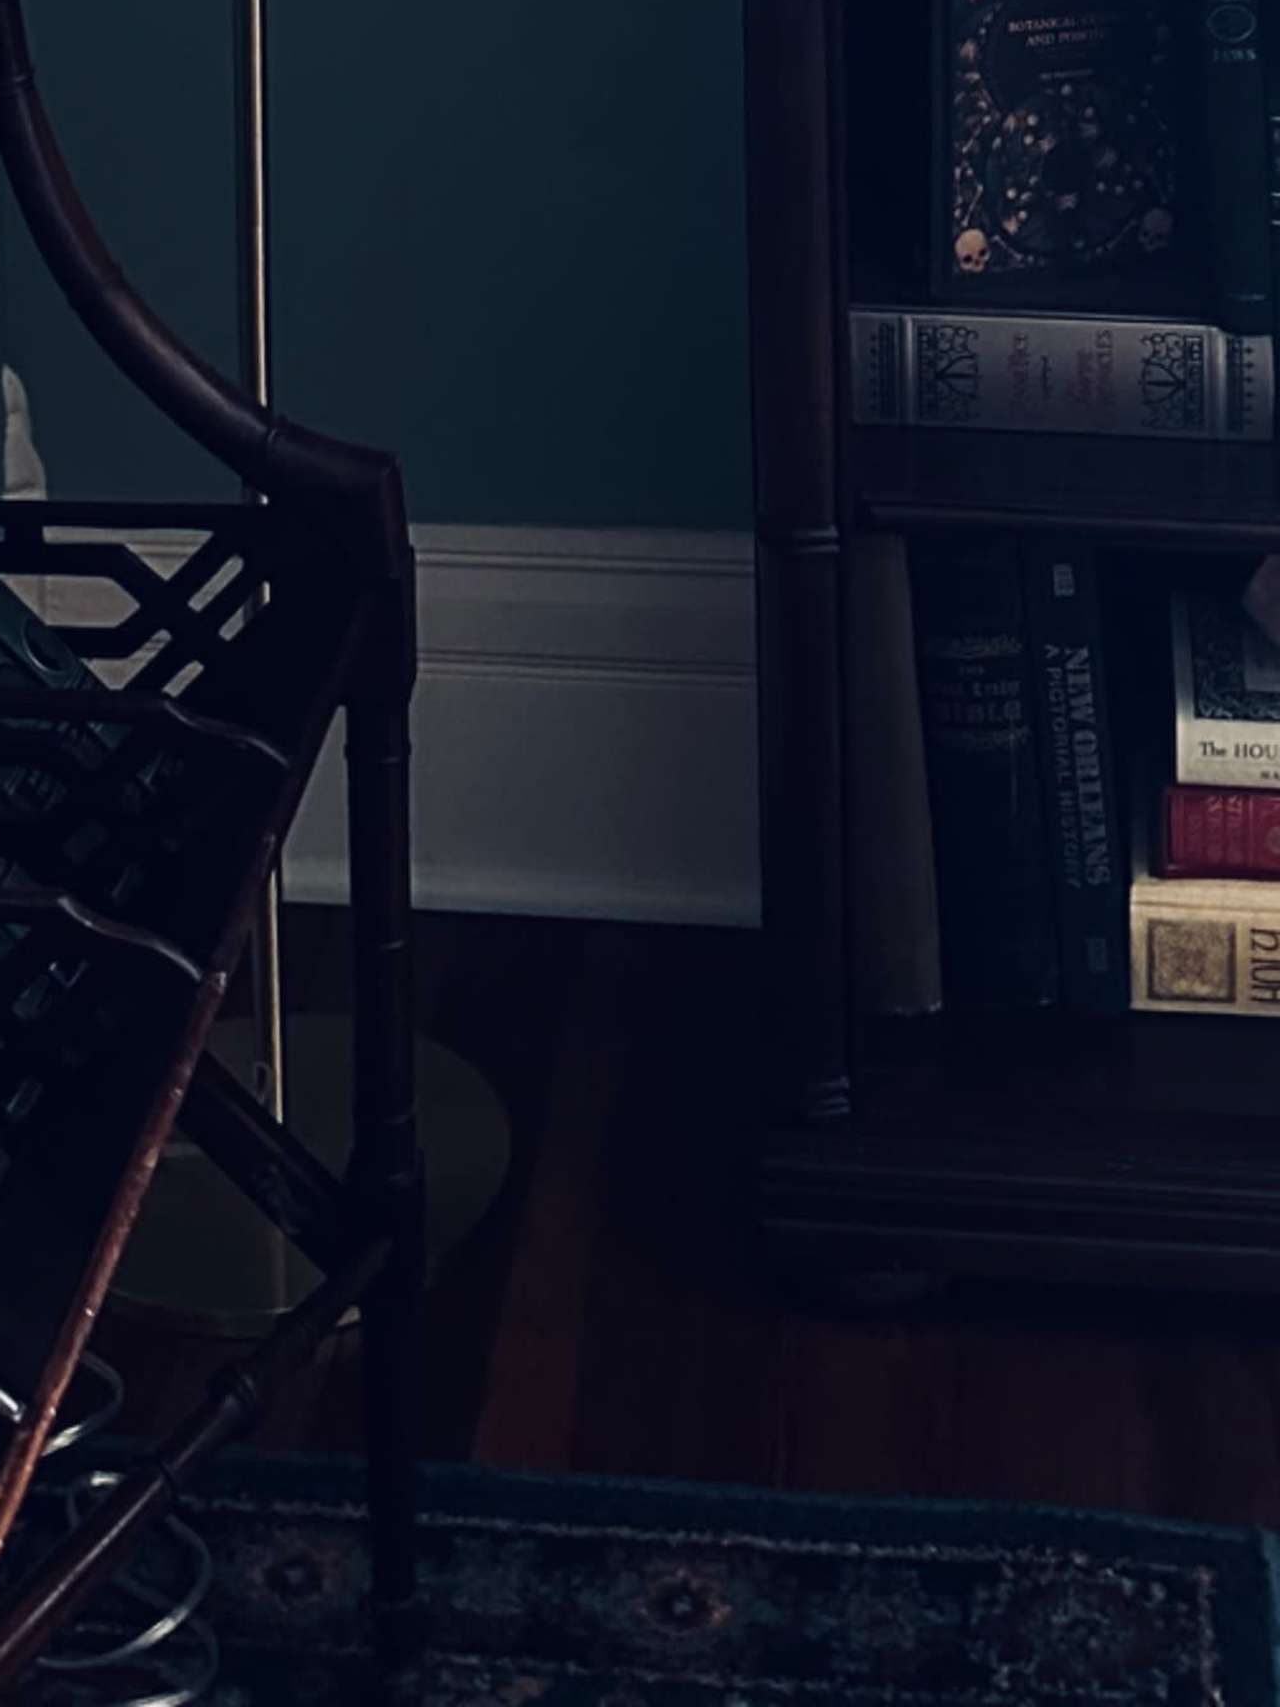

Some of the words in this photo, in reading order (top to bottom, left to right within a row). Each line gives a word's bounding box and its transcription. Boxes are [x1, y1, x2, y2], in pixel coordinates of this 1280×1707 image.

[1007, 16, 1078, 35] BOTANICAL
[1025, 31, 1056, 47] AND
[1063, 644, 1097, 727] NEW
[1046, 666, 1074, 784] PICTORIAL
[1197, 740, 1228, 760] The
[1071, 727, 1112, 888] ORLEANS
